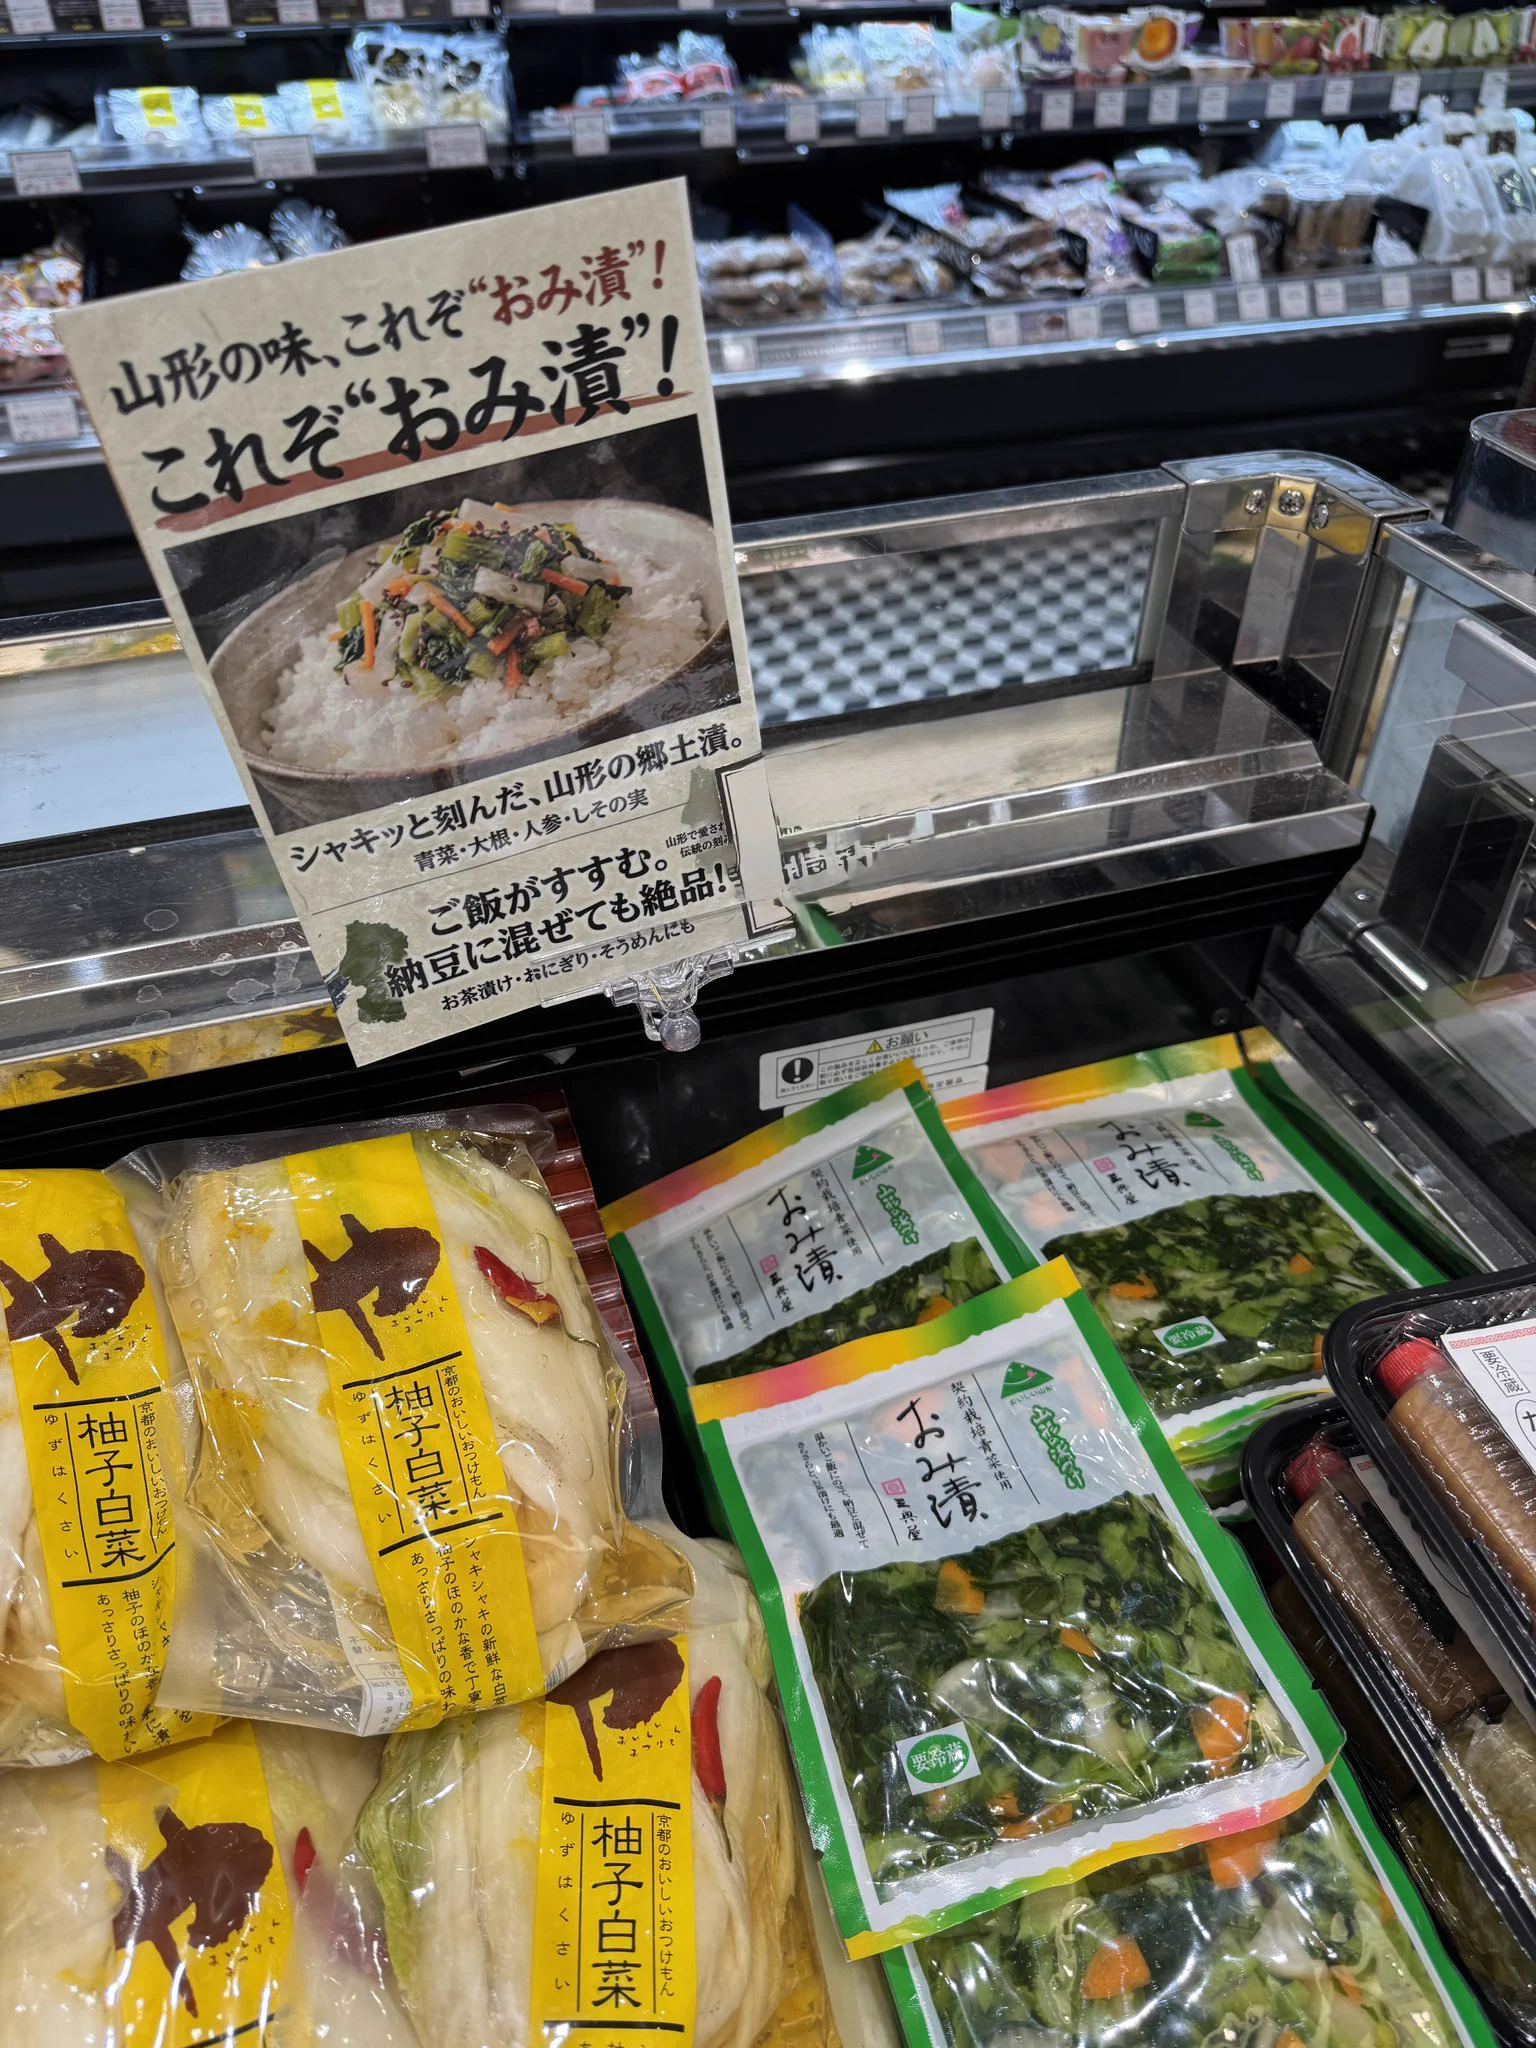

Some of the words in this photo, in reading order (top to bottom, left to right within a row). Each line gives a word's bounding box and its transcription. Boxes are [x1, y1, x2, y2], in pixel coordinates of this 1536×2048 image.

[290, 722, 743, 873] シャキッと刻んだ、山形の郷土漬。
[413, 788, 649, 872] 青菜・大根・人参・しその実
[384, 862, 727, 998] 納豆に混ぜても絶品!
[428, 847, 668, 936] ご飯がすすむ。
[441, 918, 696, 1011] お茶漬け・おにぎり・そうめんにも
[885, 1031, 928, 1049] お願い
[1098, 1120, 1192, 1190] おみ漬
[767, 1185, 844, 1293] おみ漬
[443, 1365, 487, 1500] 京都のおいしいおつけもん
[951, 1380, 1013, 1492] 契約栽培青菜使用
[1479, 1349, 1524, 1394] 要冷蔵
[44, 1413, 80, 1560] ゆずはくさい
[77, 1411, 146, 1568] 柚子白菜
[353, 1391, 392, 1525] ゆずはくさい
[385, 1381, 459, 1525] 柚子白菜
[896, 1396, 989, 1529] おみ漬
[410, 1552, 457, 1714] あっさりさっぱりの味わ
[436, 1542, 483, 1710] 柚子のほのかな香で丁寧
[554, 1811, 575, 1991] ゆずはくさい
[591, 1815, 643, 2009] 柚子白菜
[655, 1814, 675, 1998] 京都のおいしいおつけもん
